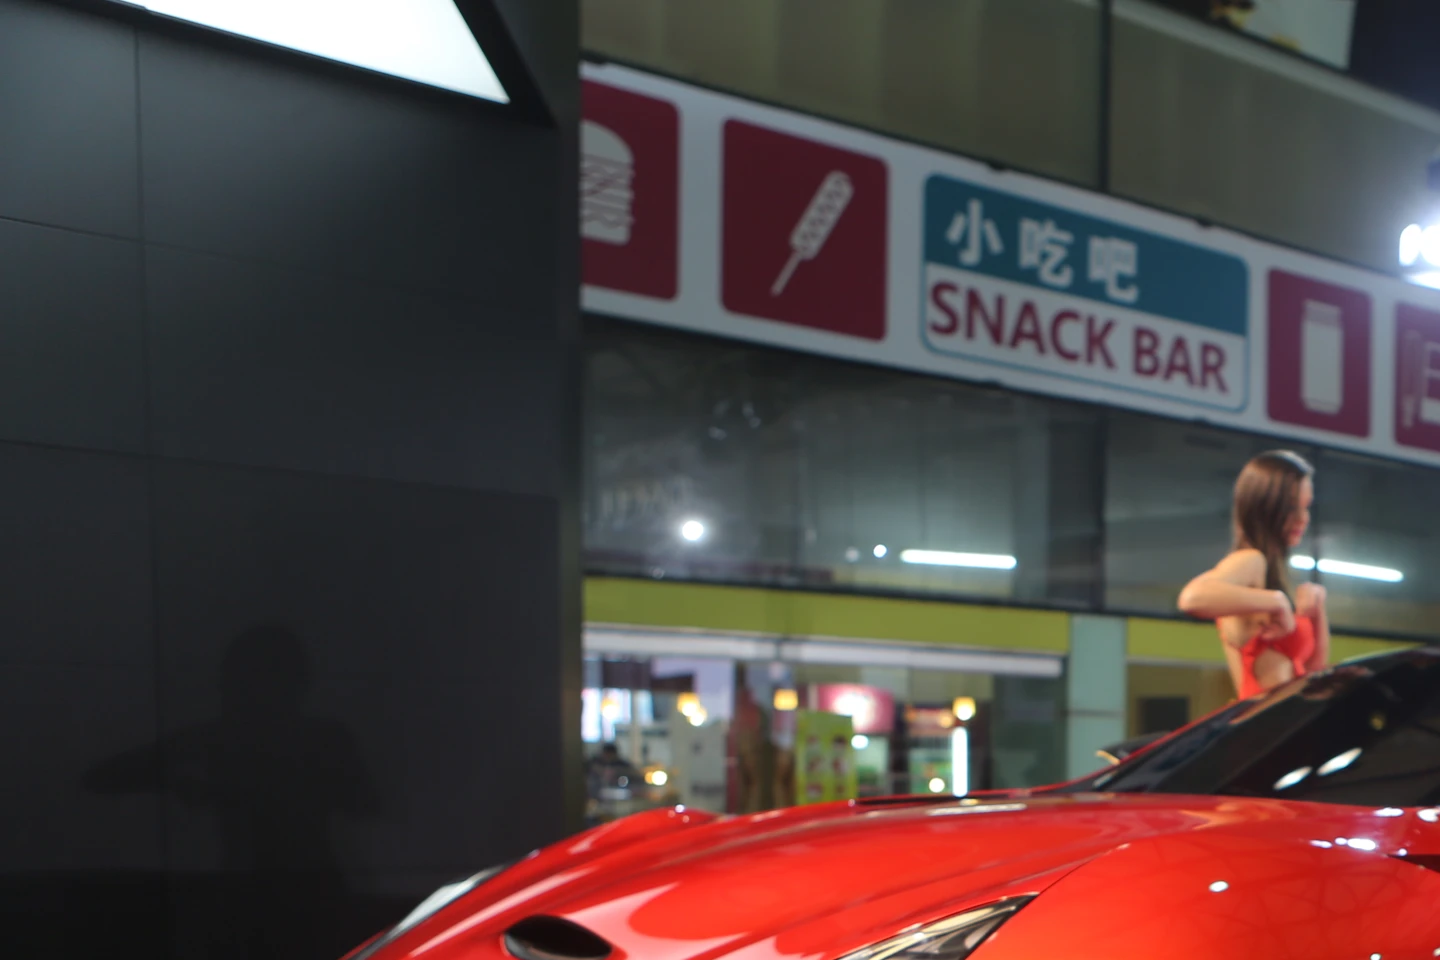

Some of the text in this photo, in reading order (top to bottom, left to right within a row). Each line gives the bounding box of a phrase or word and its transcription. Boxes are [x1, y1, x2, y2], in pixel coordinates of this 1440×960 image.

[946, 199, 1139, 304] 小吃吧
[929, 279, 1230, 395] SNACK BAR
